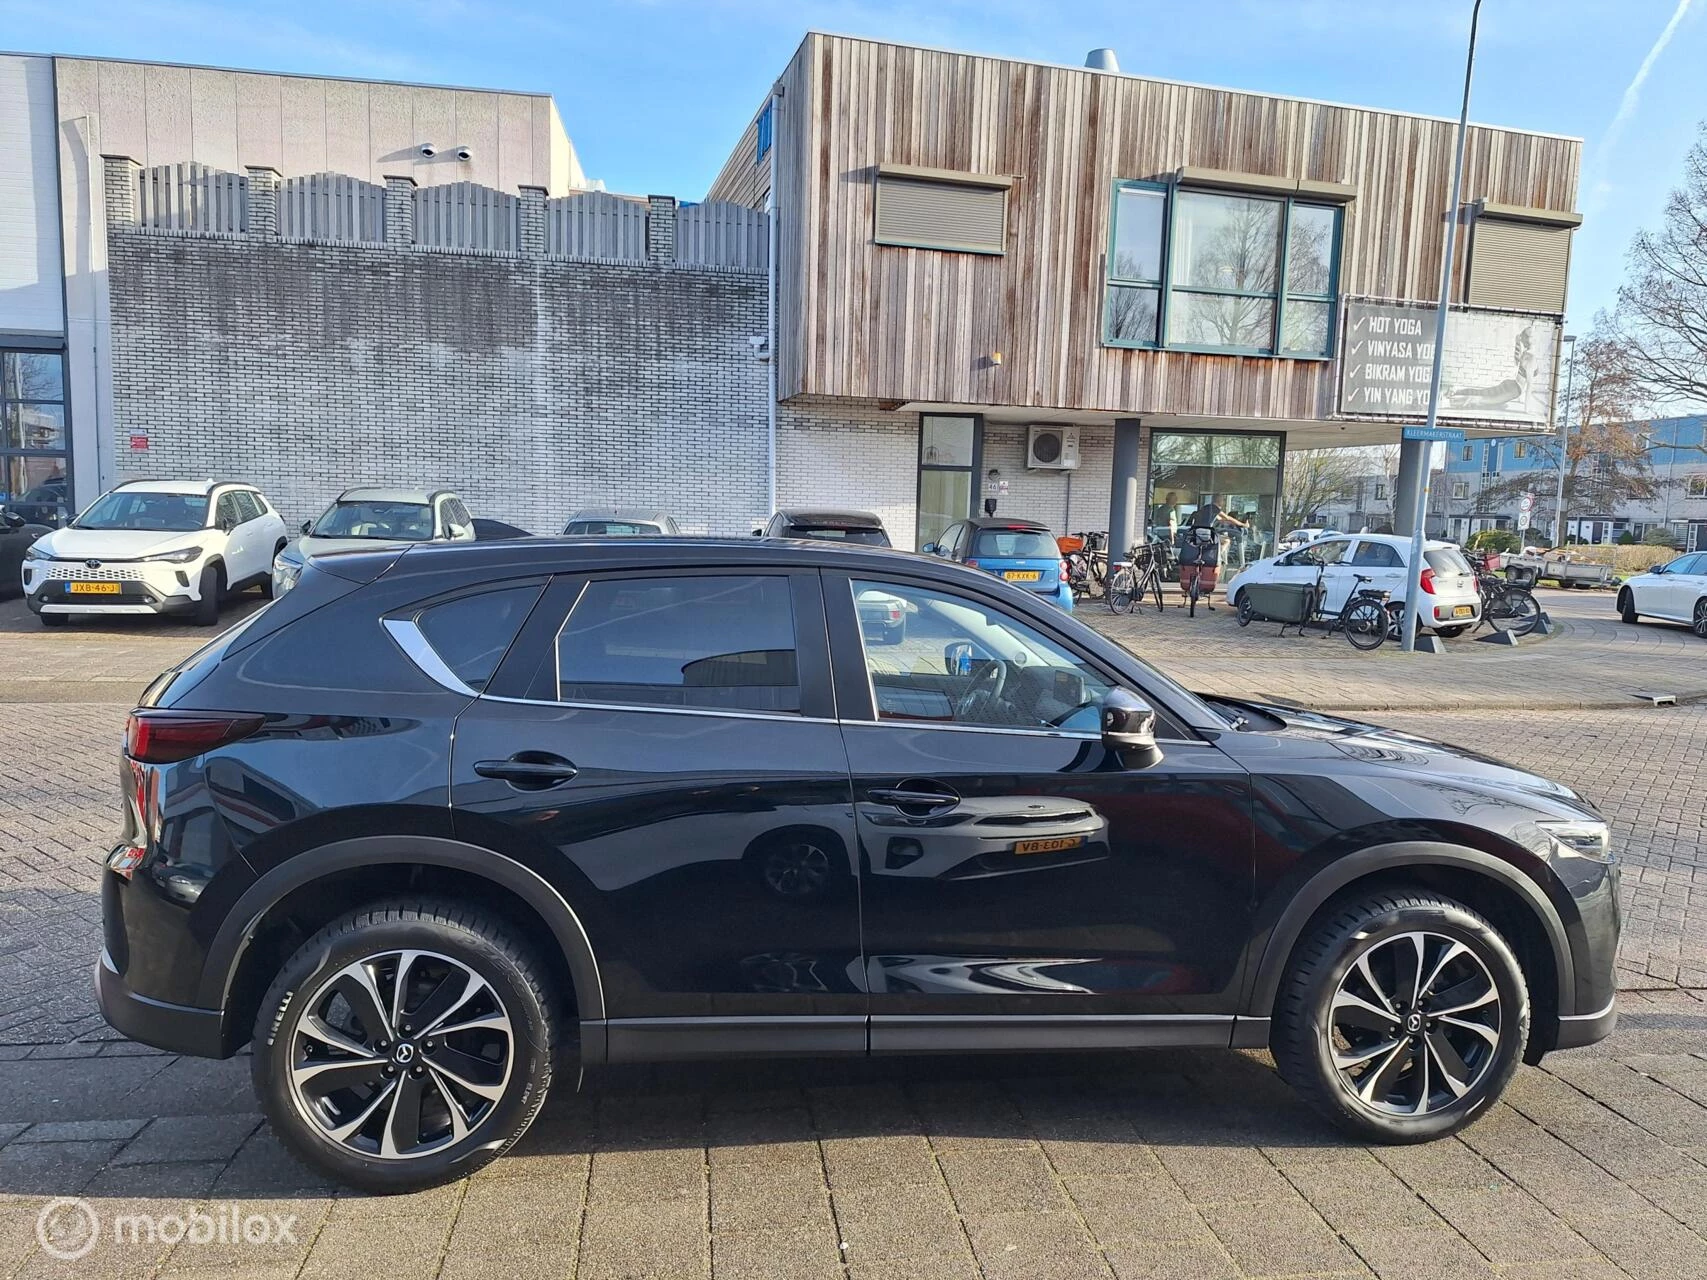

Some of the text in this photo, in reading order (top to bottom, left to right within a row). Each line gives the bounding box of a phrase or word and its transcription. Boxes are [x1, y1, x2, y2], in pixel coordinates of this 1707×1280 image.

[1369, 316, 1422, 336] HOT YOGA
[1367, 340, 1413, 359] VINYASA
[1365, 364, 1432, 383] BIKRAM YOG
[1364, 387, 1382, 403] YIN
[1386, 388, 1413, 405] YANG
[73, 583, 116, 592] JXB-46-J
